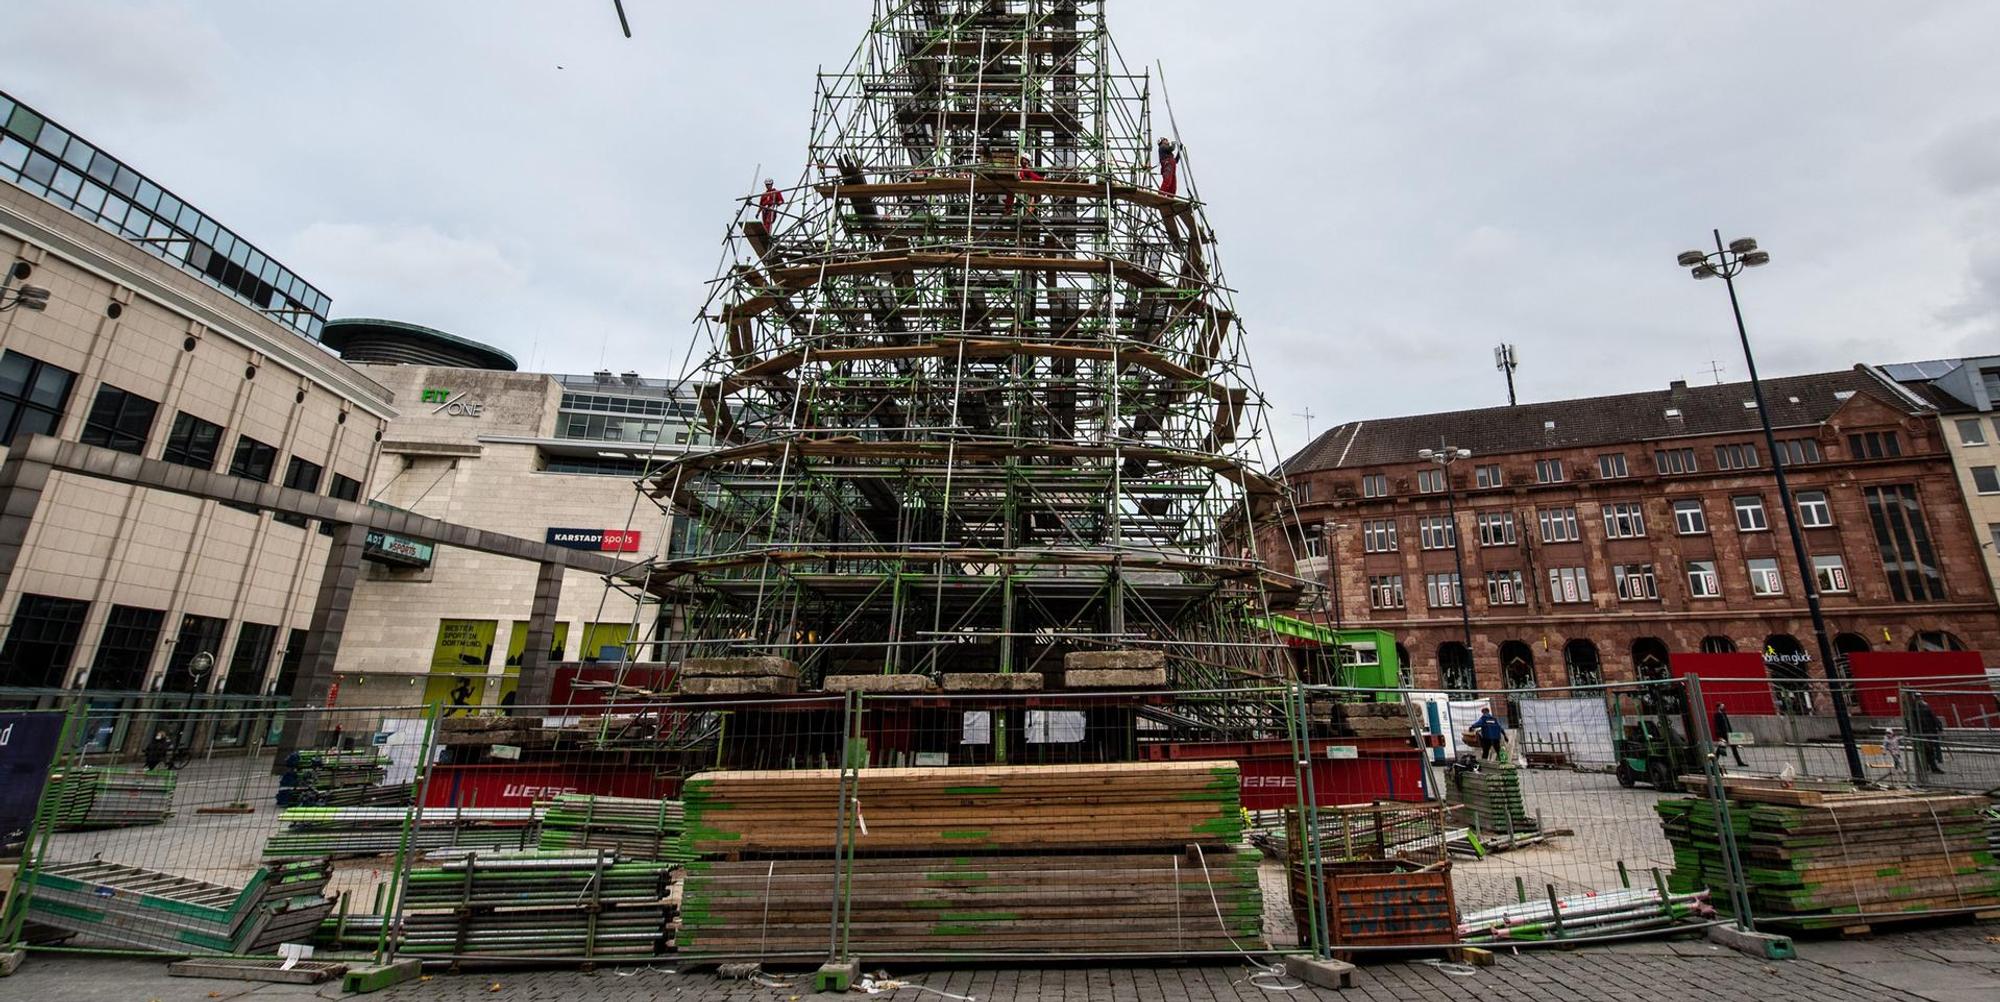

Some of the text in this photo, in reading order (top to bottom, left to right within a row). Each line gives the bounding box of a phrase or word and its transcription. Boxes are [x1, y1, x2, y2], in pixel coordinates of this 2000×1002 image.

[421, 386, 450, 403] FIT
[447, 402, 482, 418] ONE
[554, 533, 633, 545] KARSTADT spots
